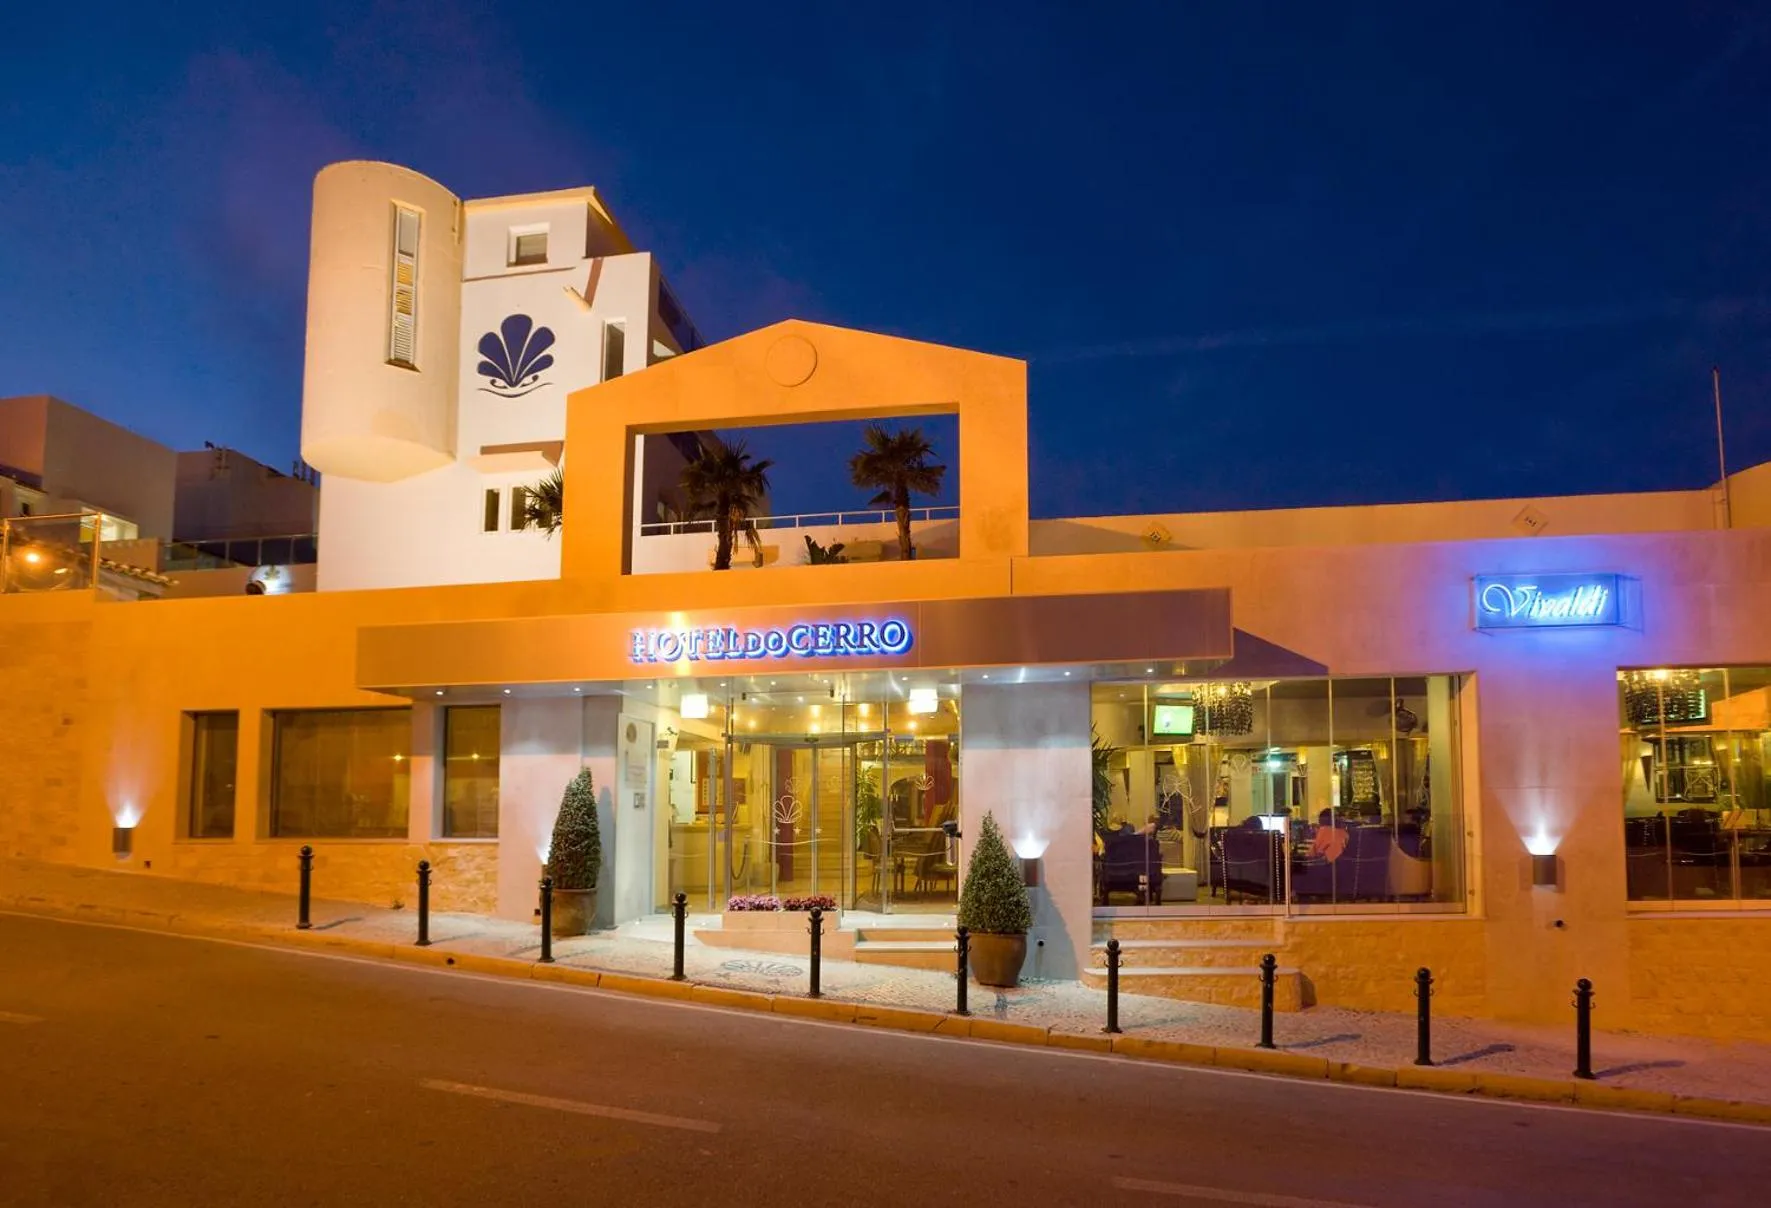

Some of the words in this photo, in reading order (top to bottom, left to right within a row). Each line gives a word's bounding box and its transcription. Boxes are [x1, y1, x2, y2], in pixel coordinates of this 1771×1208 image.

[1482, 583, 1608, 619] Vivaldi
[629, 627, 745, 661] HOTEL
[786, 620, 912, 655] CERRO
